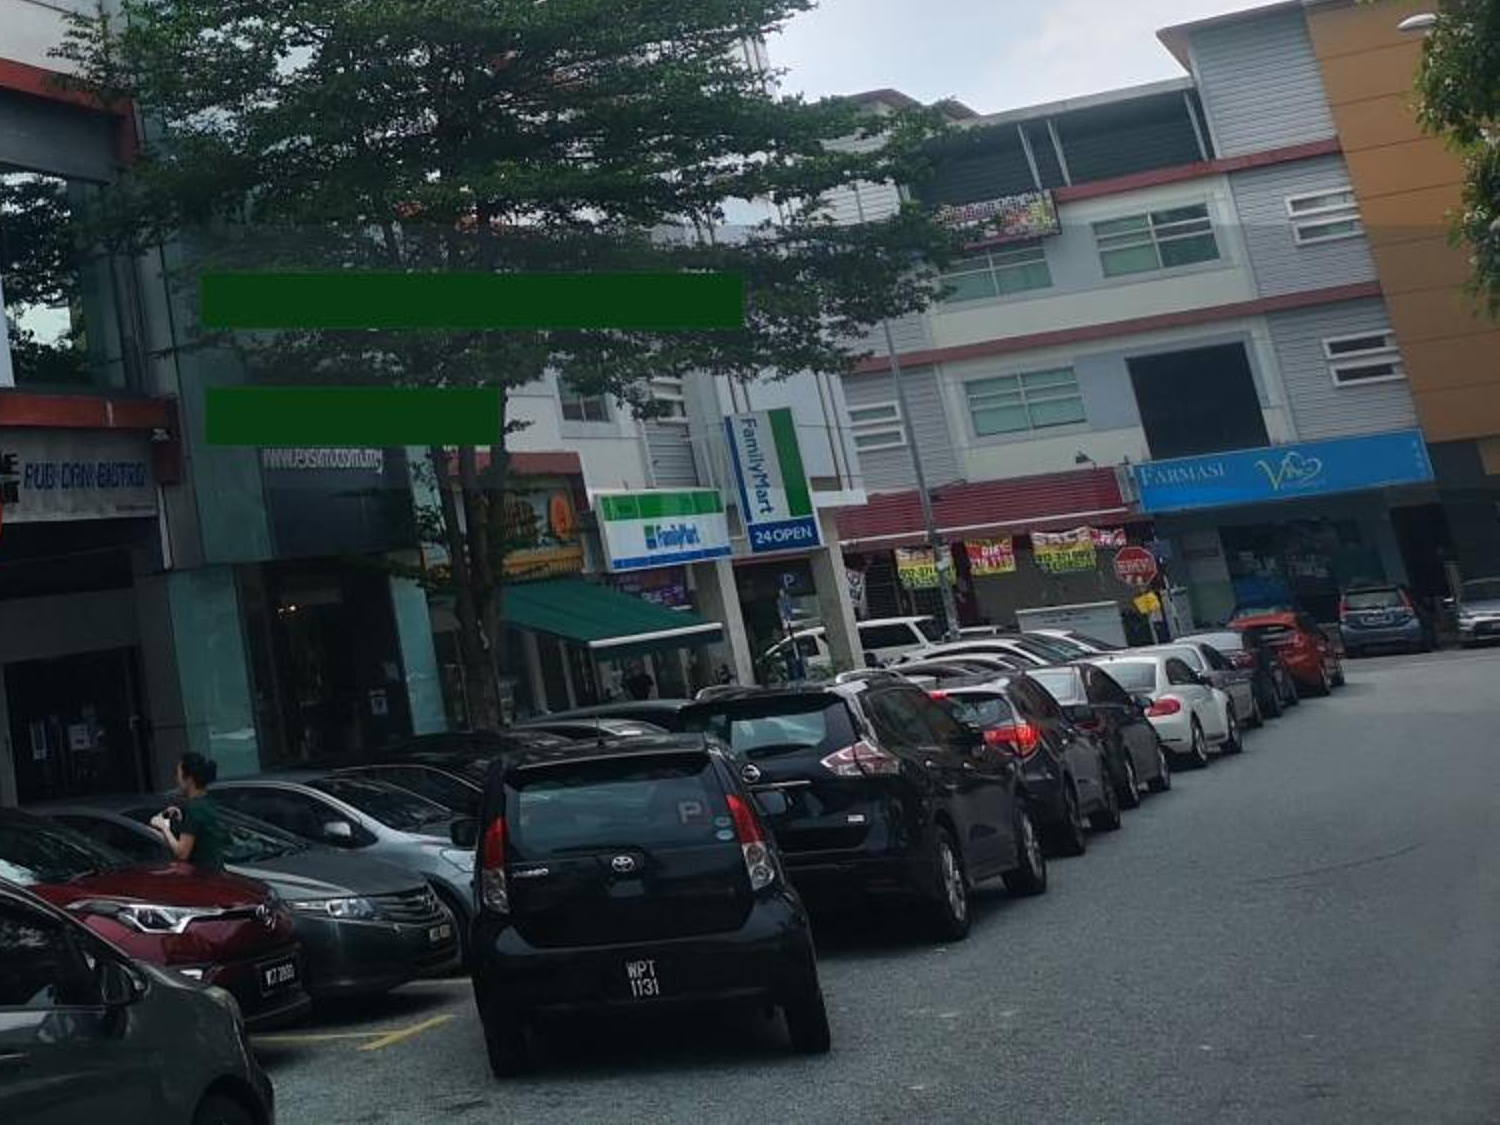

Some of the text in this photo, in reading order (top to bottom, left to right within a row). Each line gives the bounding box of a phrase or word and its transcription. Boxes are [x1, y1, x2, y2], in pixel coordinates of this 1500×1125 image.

[739, 418, 775, 515] FamilyMart
[1139, 462, 1228, 488] FARMASI
[755, 525, 812, 544] 24 OPEN
[626, 960, 657, 979] WPT
[630, 977, 660, 998] 1131
